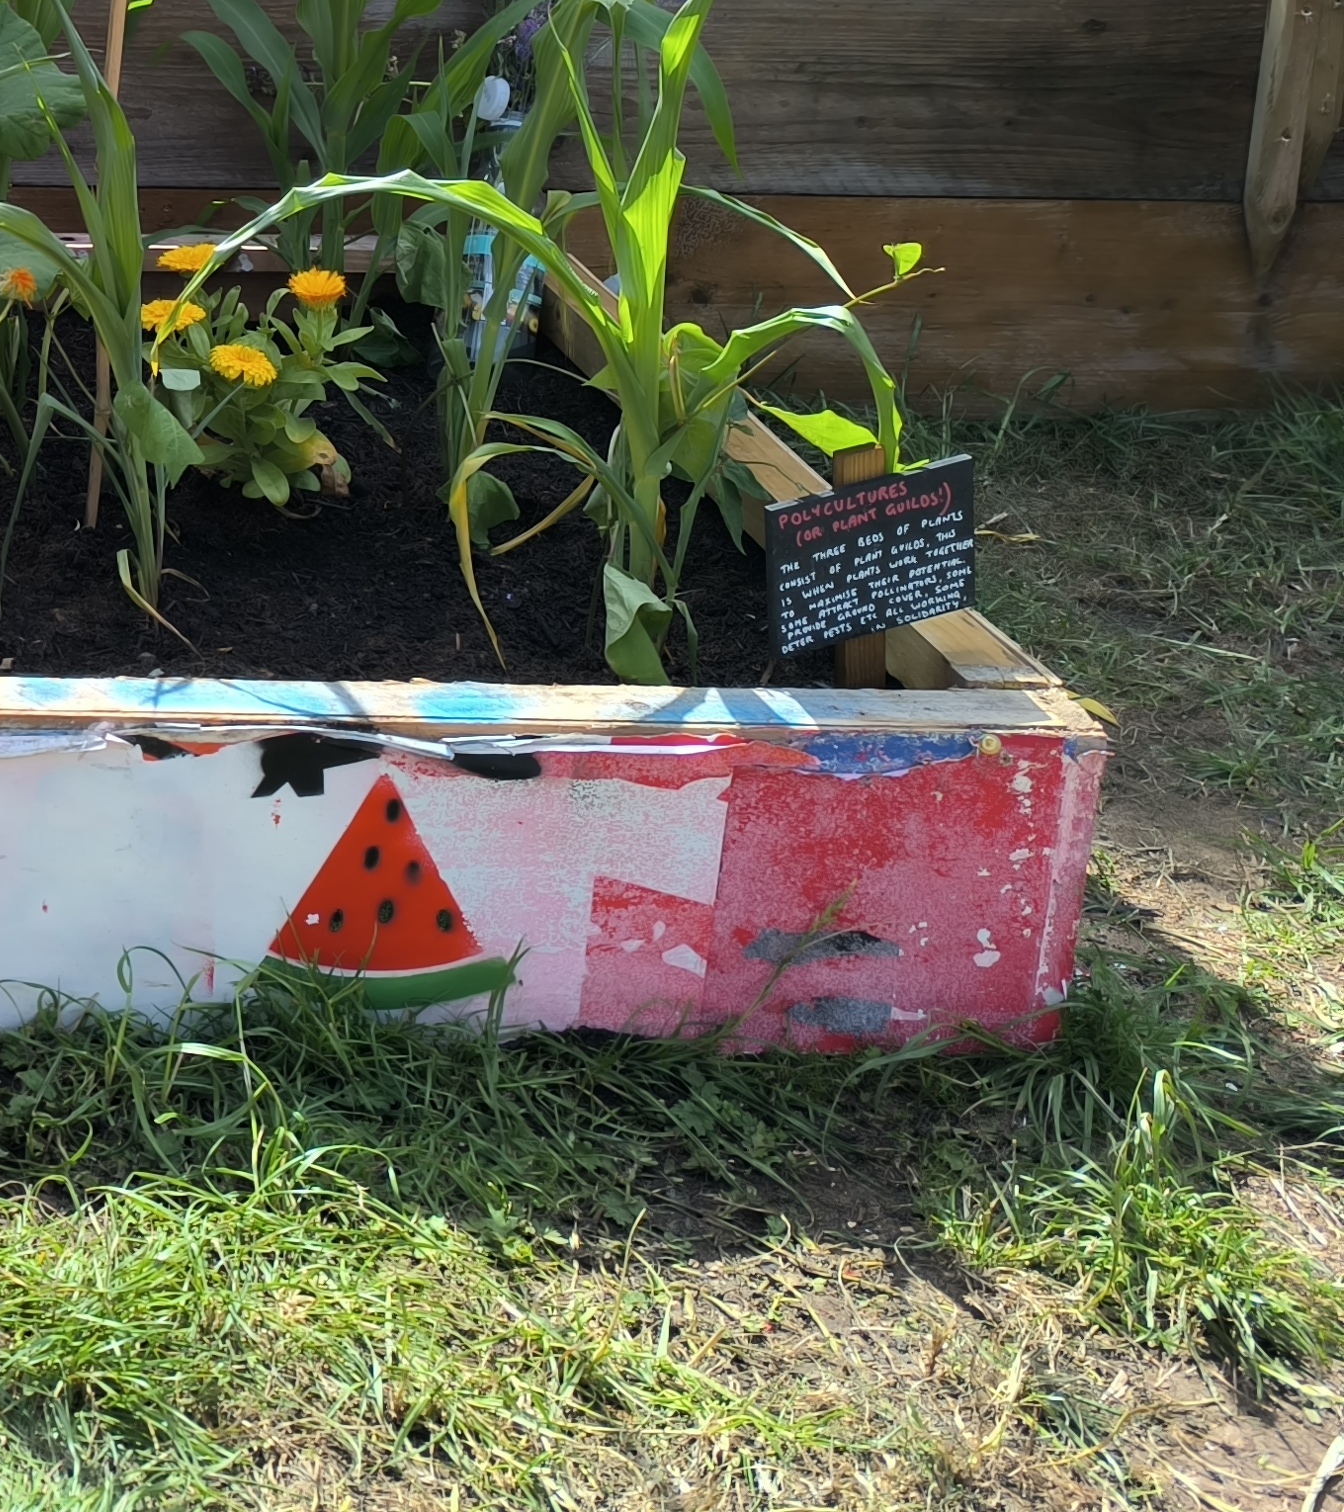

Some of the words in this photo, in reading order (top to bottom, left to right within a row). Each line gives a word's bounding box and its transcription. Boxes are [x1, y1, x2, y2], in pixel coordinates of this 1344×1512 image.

[778, 480, 908, 531] POLYCULTURES
[796, 525, 823, 548] (OR
[832, 507, 878, 533] PLANT
[885, 482, 952, 517] GUILDS!)
[779, 571, 817, 592] CONSIST
[829, 562, 842, 575] OF
[853, 549, 883, 567] PLANT
[935, 528, 957, 542] THIS
[780, 561, 801, 575] THE
[812, 543, 847, 563] THREE
[857, 531, 885, 548] BEDS
[896, 523, 911, 536] OF
[921, 509, 964, 529] PLANTS
[781, 597, 793, 608] IS
[801, 581, 835, 599] WHEN
[846, 565, 881, 584] PLANTS
[888, 555, 919, 569] WORK
[925, 539, 975, 559] TOGETHER
[780, 609, 796, 619] TO
[808, 588, 858, 611] MAXIMISE
[867, 574, 900, 590] THEIR
[781, 616, 809, 634] SOME
[818, 597, 859, 620] ATTRACT
[946, 565, 973, 580] SOME
[787, 619, 827, 641] PROVIDE
[837, 603, 876, 621] GROUND
[935, 578, 966, 595] SOME
[871, 622, 886, 632] IN
[895, 600, 960, 625] SOLIDARITY
[781, 635, 815, 655] DETER
[823, 622, 853, 640] PESTS
[860, 612, 878, 625] ETC
[885, 607, 904, 618] ALL
